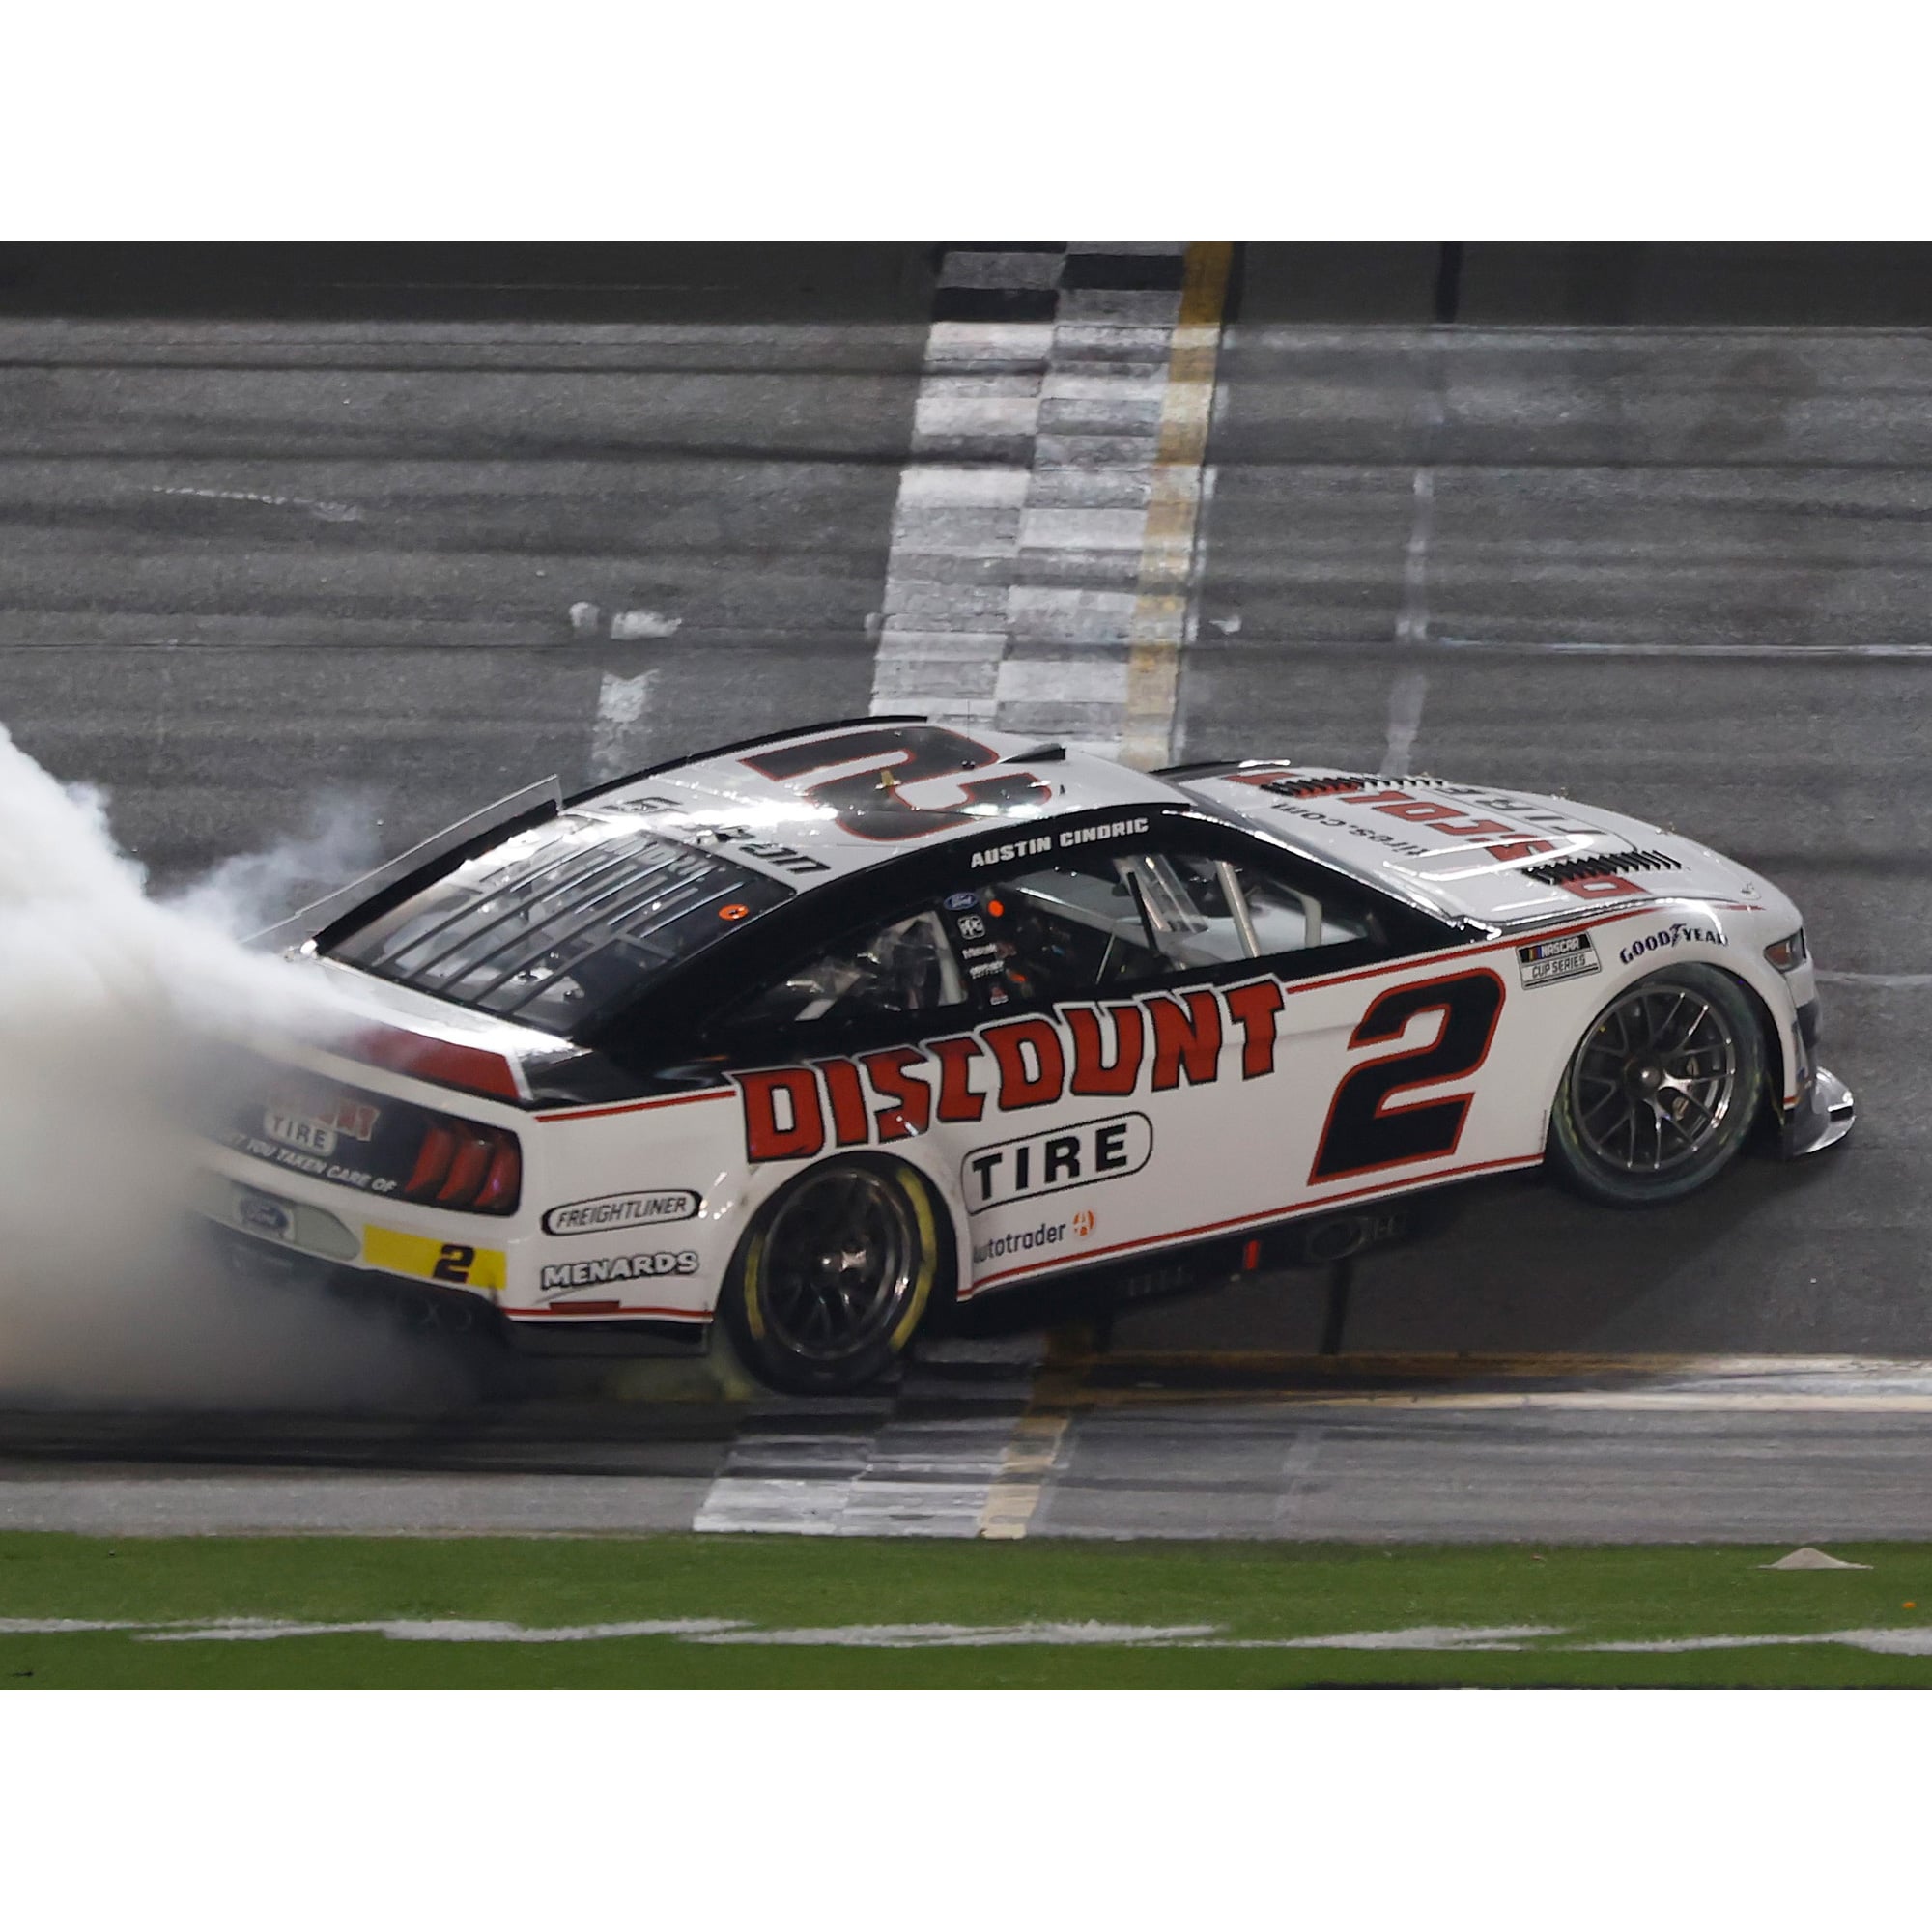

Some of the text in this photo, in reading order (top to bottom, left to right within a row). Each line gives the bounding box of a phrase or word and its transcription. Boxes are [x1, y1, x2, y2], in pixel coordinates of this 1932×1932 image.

[971, 818, 1150, 868] AUSTIN CINDRIC
[1531, 953, 1586, 979] CUP SERIES
[1541, 937, 1579, 957] NASCAR
[731, 977, 1286, 1162] DISCOUNT
[1306, 966, 1507, 1186] 2
[271, 1114, 327, 1149] TIRE
[247, 1138, 275, 1158] YOU
[275, 1149, 328, 1175] TAKEN
[327, 1165, 372, 1188] CARE
[372, 1178, 398, 1193] OF
[972, 1123, 1127, 1201] TIRE
[556, 1196, 689, 1229] FREIGHTLINER
[432, 1243, 475, 1284] 2
[540, 1250, 700, 1292] MENARDS
